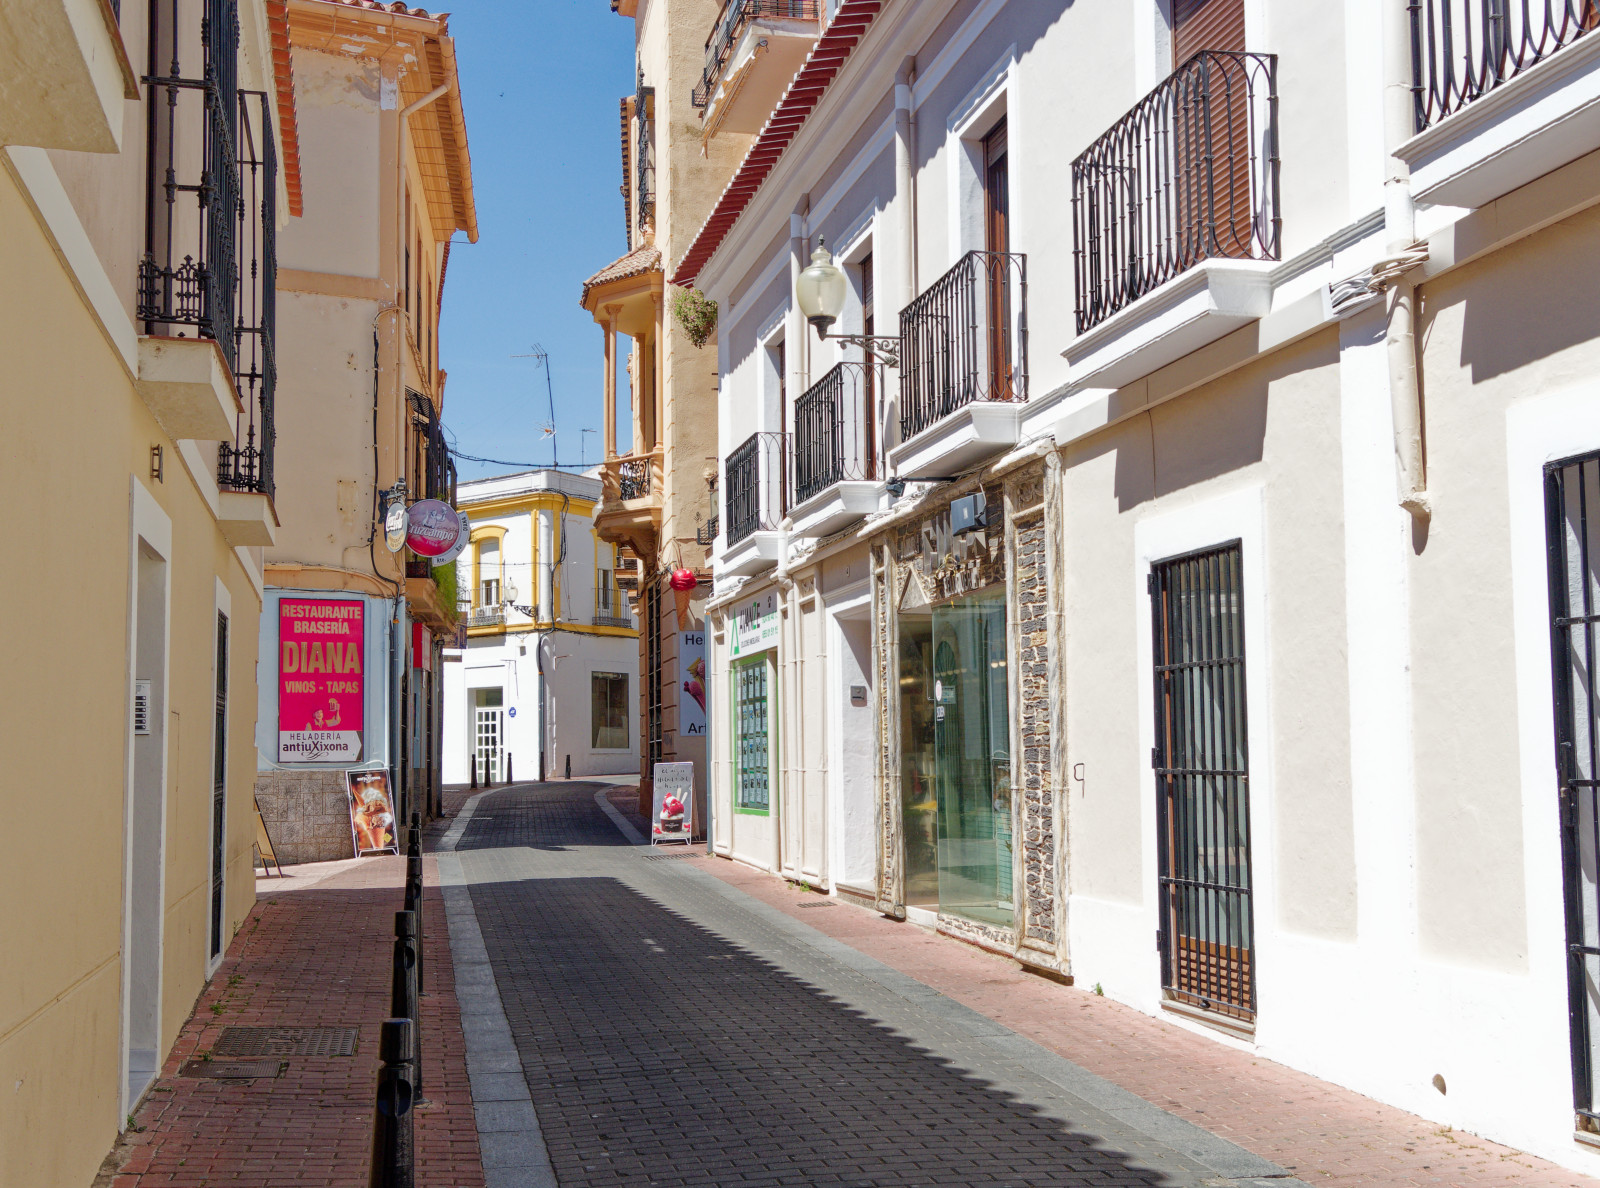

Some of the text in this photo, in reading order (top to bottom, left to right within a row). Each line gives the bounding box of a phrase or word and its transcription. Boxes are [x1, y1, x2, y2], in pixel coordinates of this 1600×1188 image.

[408, 524, 454, 541] ruzcampo
[282, 604, 361, 619] RESTAURANTE
[293, 619, 350, 634] BRASERÍA
[282, 641, 361, 674] DIANA
[285, 681, 316, 693] VINOS
[326, 681, 359, 694] TAPAS
